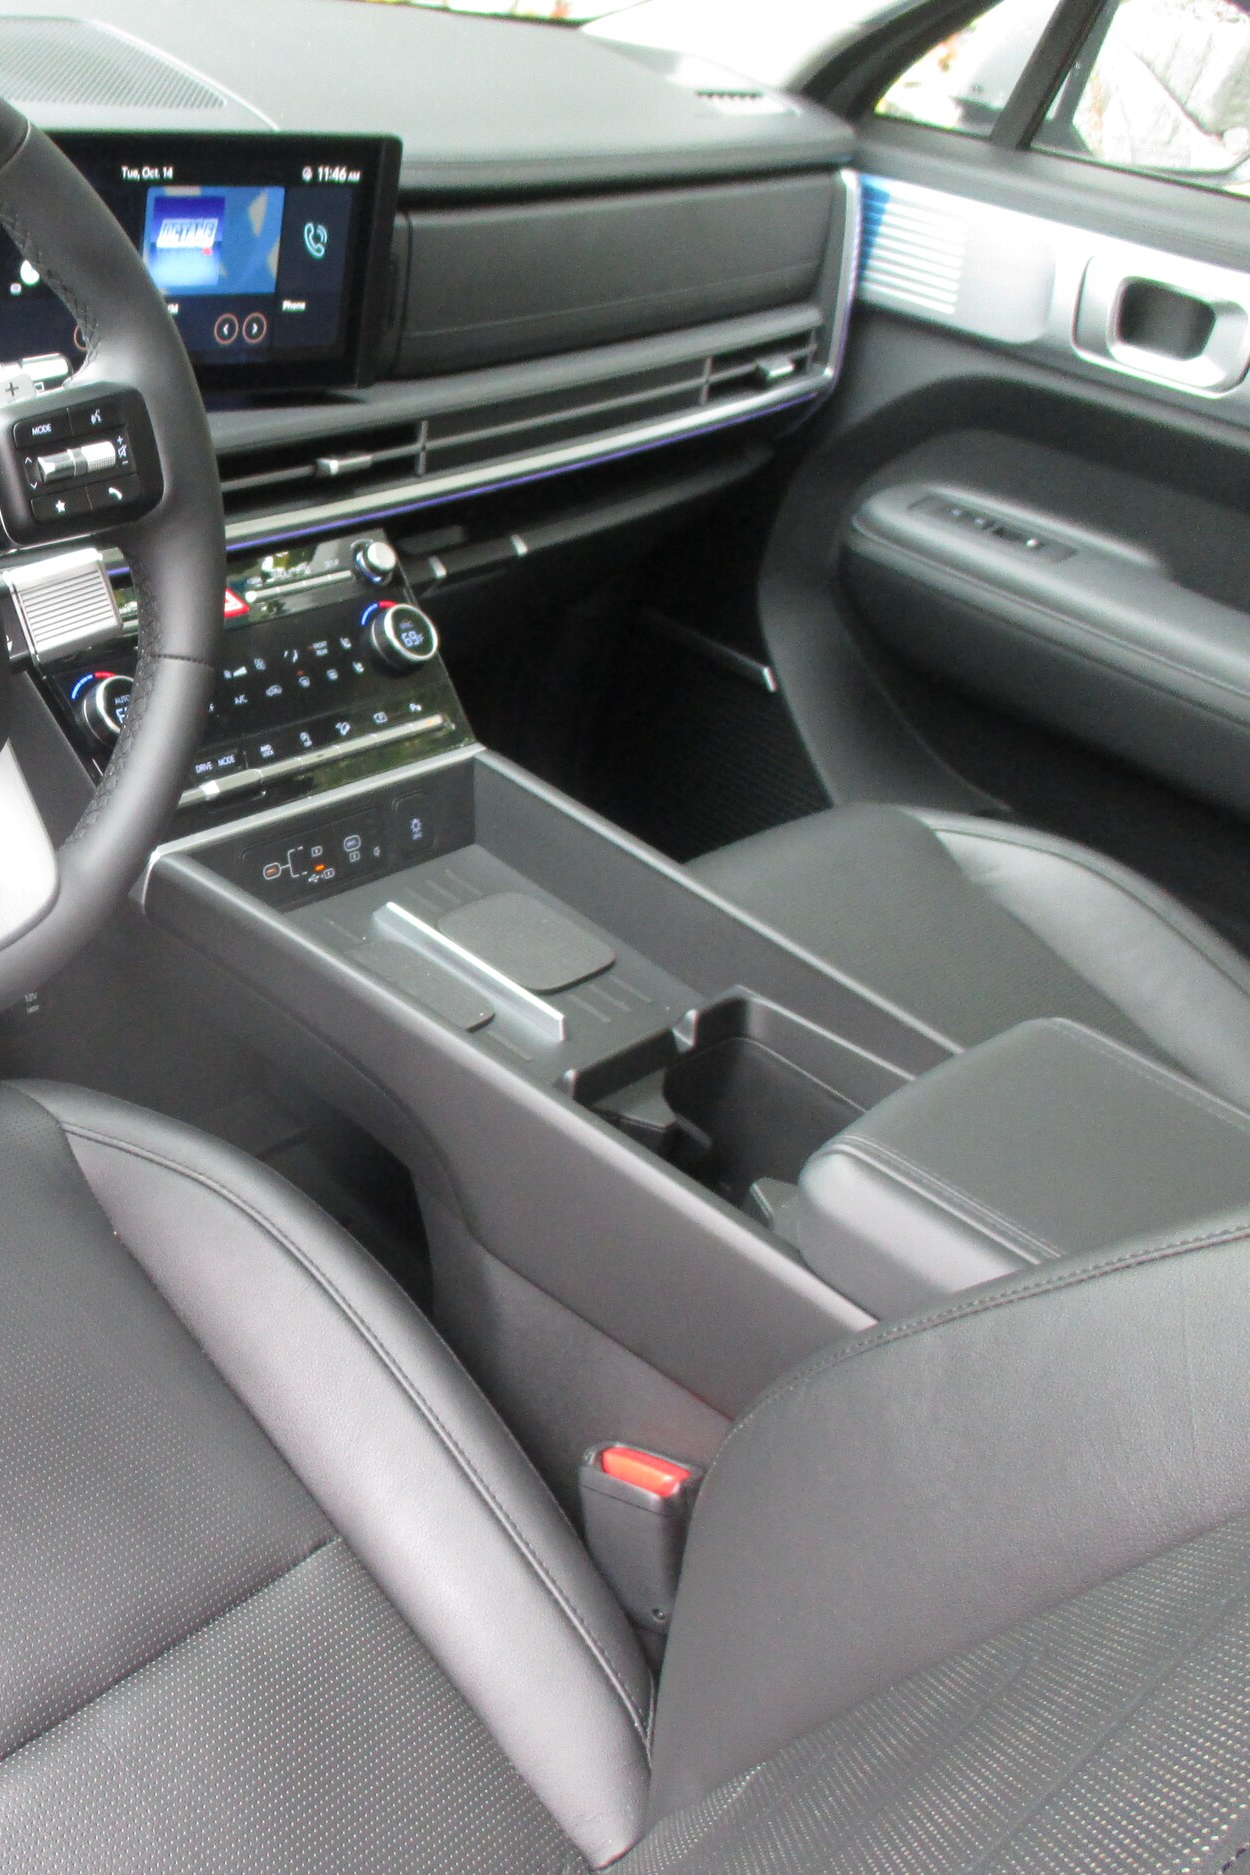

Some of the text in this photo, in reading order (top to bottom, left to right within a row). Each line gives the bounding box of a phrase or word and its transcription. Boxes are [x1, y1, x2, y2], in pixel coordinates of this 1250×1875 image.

[121, 165, 140, 180] Tue,
[162, 166, 174, 179] 14
[317, 165, 348, 182] 11:46
[31, 424, 52, 436] MODE
[195, 755, 236, 774] DRIVE MODE
